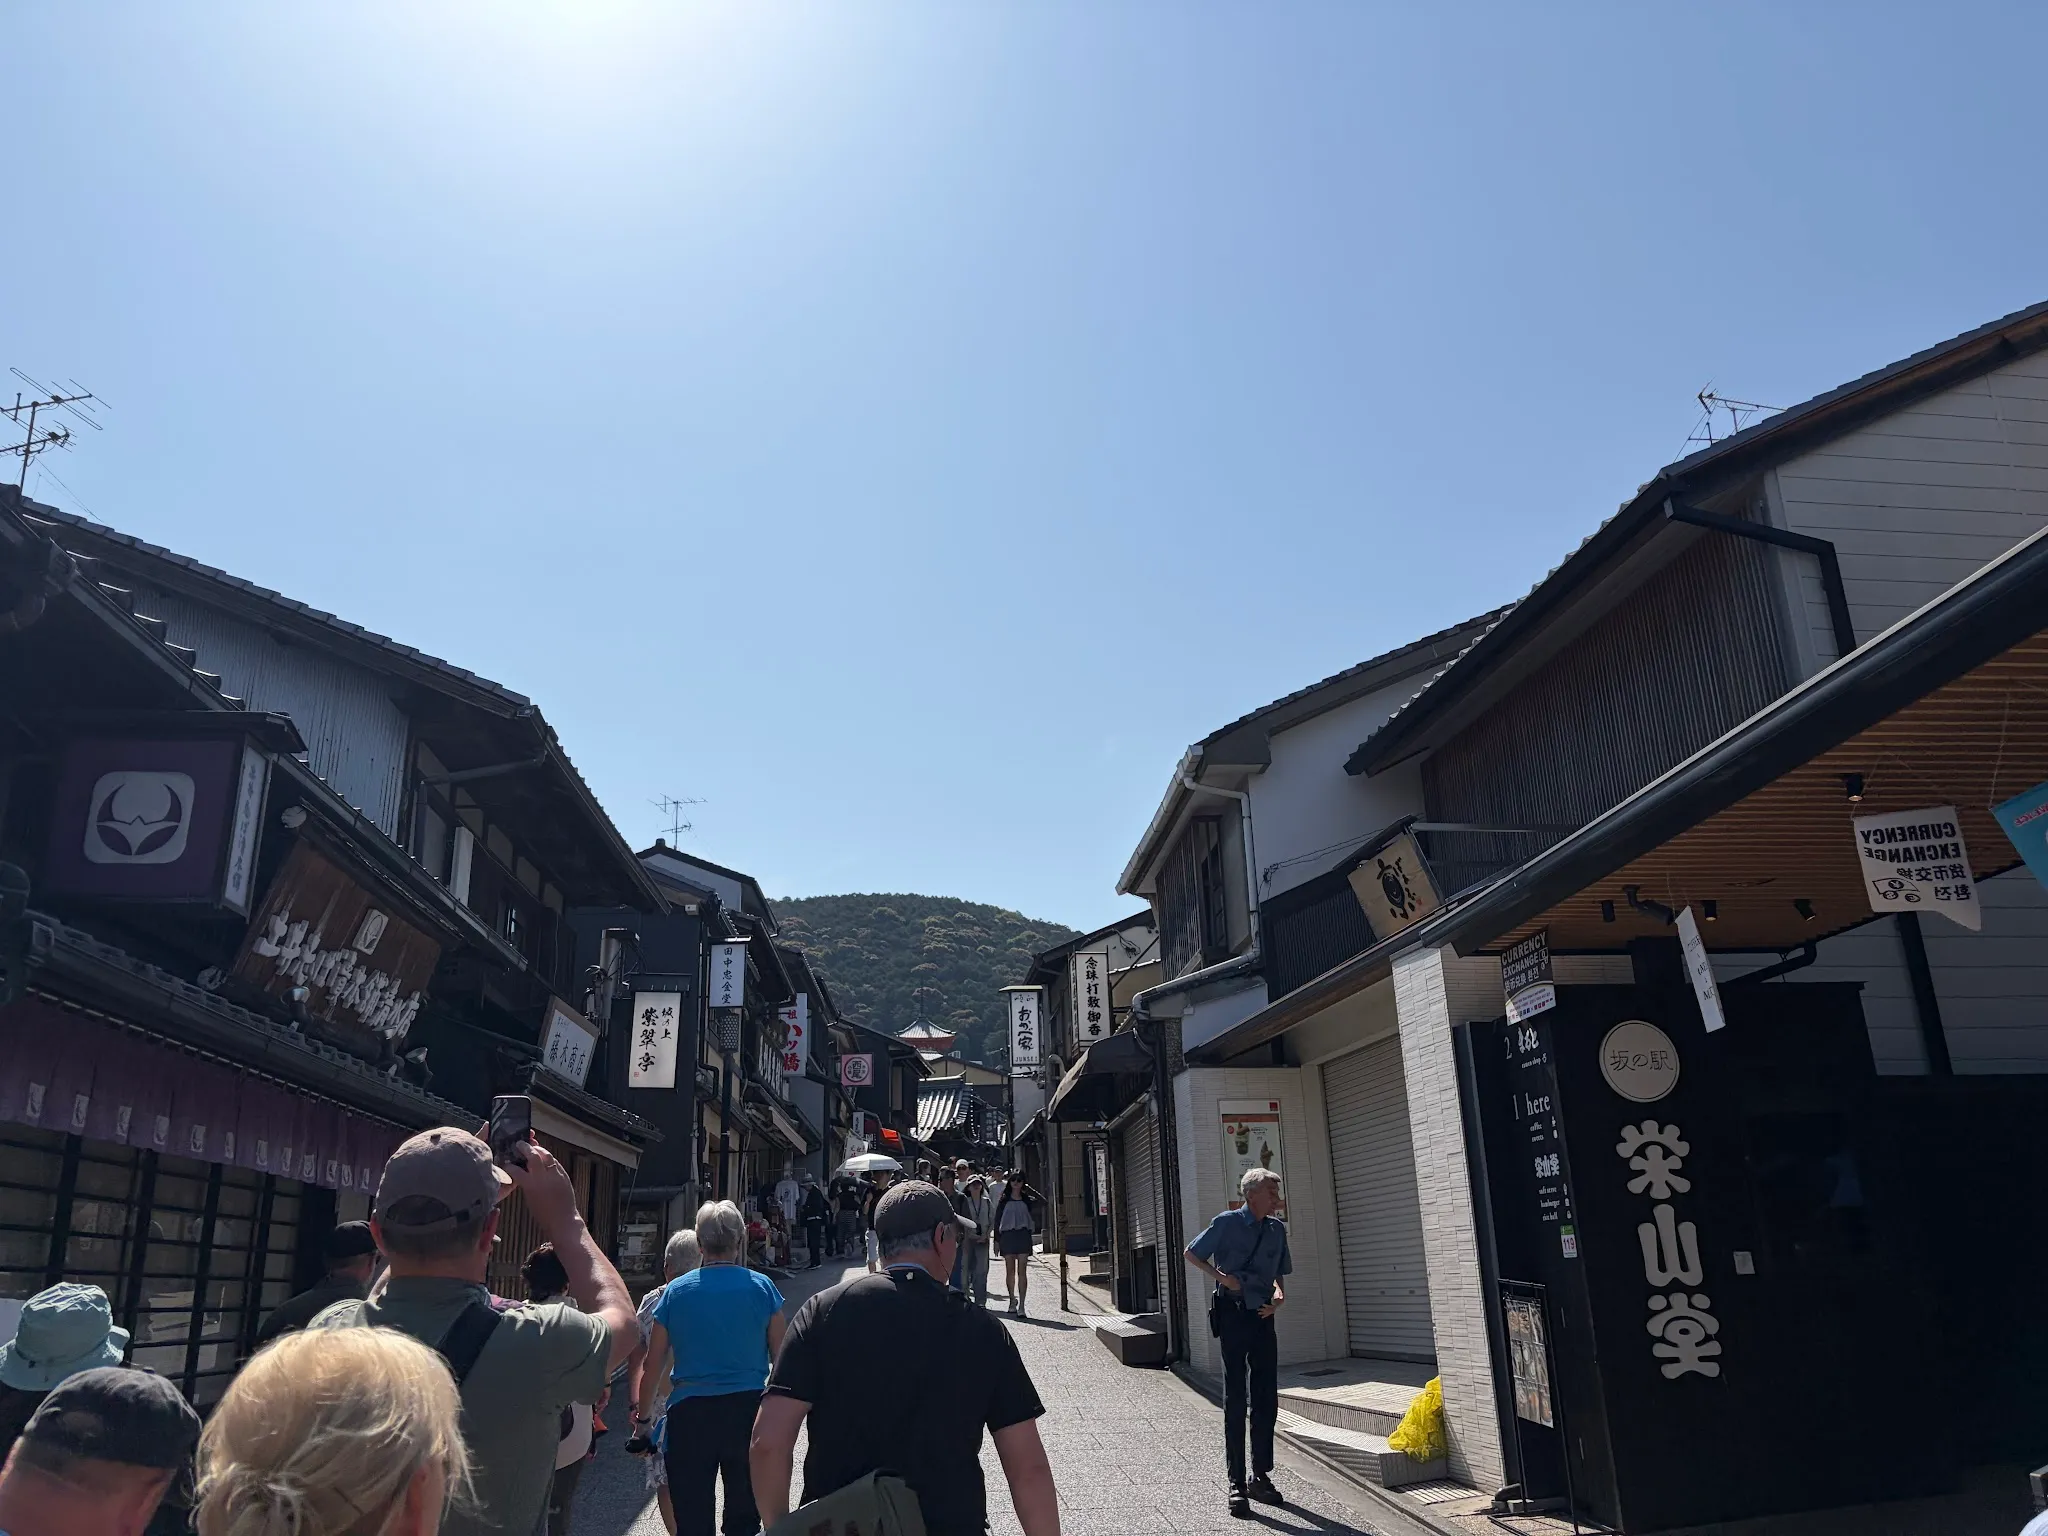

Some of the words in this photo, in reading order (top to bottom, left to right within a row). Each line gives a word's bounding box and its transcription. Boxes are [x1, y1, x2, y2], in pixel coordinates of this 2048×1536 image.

[1501, 931, 1546, 966] CURRENCY
[721, 946, 733, 1004] 田中忠金堂
[1503, 952, 1539, 979] EXCHANGE
[660, 1006, 674, 1040] 坂の上
[1018, 1005, 1034, 1051] おかべ家
[638, 1006, 659, 1072] 紫翠亭
[1503, 1036, 1513, 1060] 2
[851, 1060, 862, 1079] 西尾
[1610, 1049, 1674, 1071] 坂の駅
[1525, 1092, 1551, 1116] here
[1563, 1237, 1576, 1251] 119
[1616, 1119, 1721, 1379] 栄山堂
